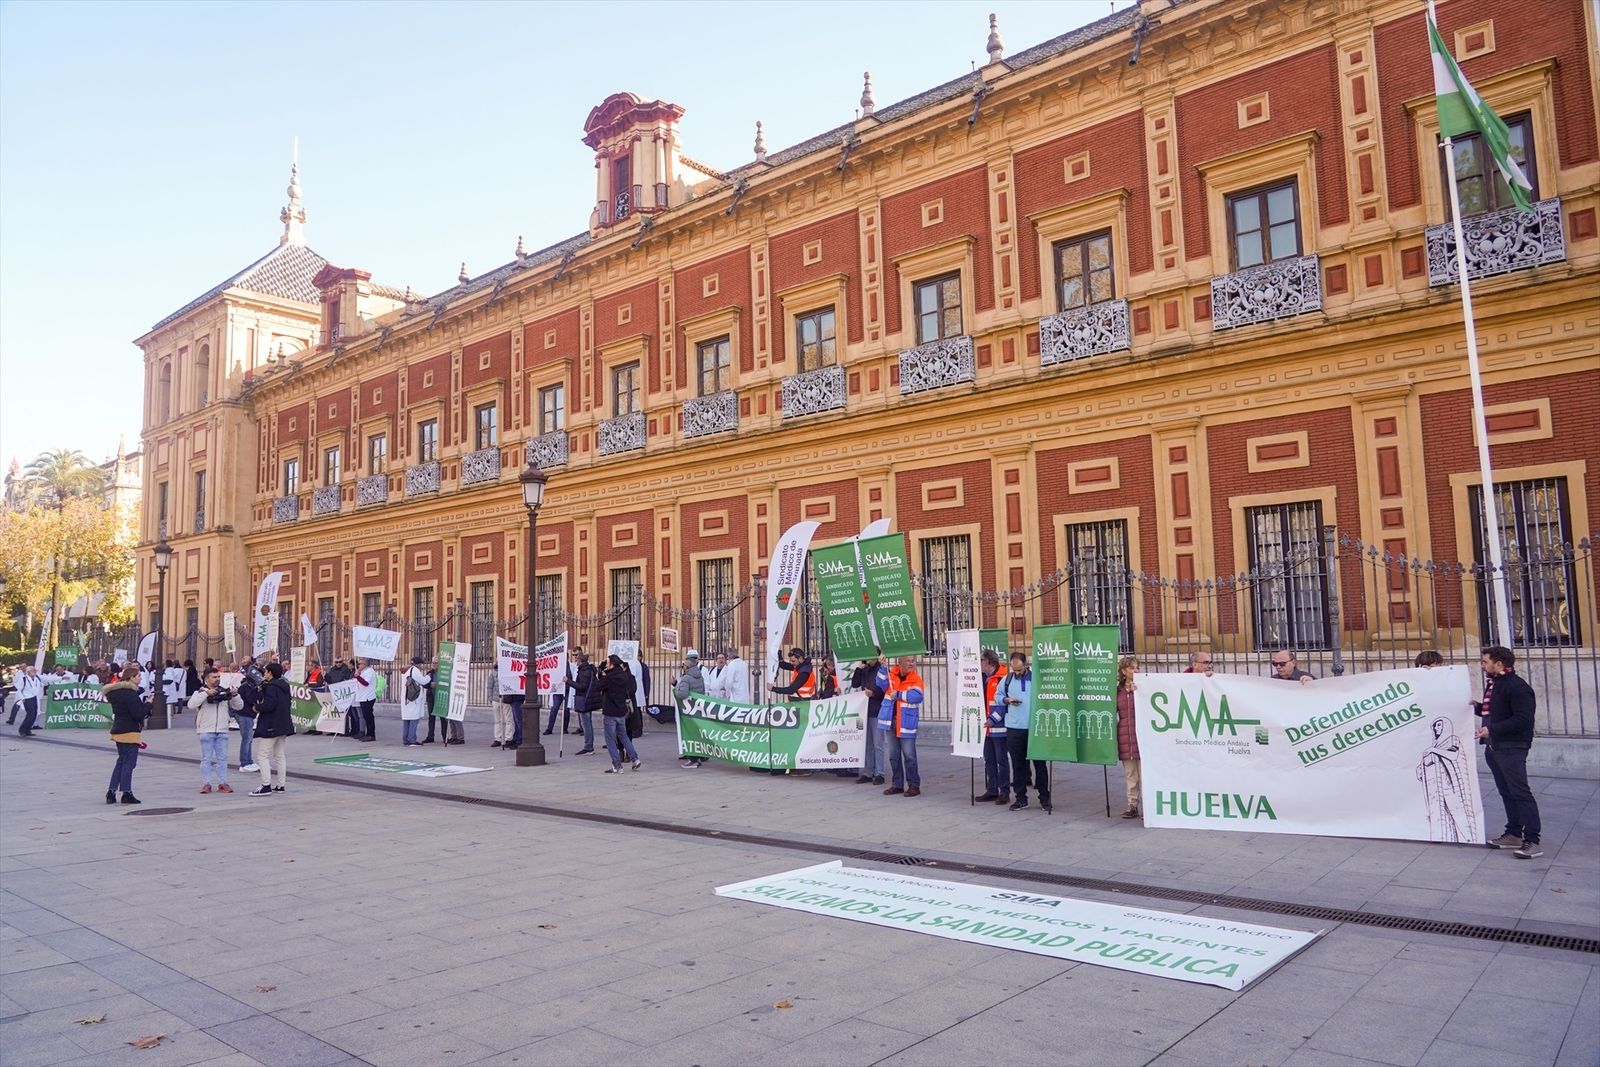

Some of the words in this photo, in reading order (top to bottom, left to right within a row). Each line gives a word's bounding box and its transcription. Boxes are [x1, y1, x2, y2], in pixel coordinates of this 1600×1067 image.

[777, 545, 788, 585] Sindicato
[785, 553, 795, 585] Médico
[790, 540, 797, 551] de
[818, 560, 850, 574] SMA
[866, 552, 899, 566] SMA
[826, 581, 854, 589] SINDICATO
[873, 573, 901, 581] SINDICATO
[877, 590, 903, 598] ANDALUZ
[829, 607, 859, 616] CÓRDOBA
[876, 600, 907, 609] CÓRDOBA
[257, 623, 267, 647] SMA
[56, 648, 75, 659] SMA
[1037, 641, 1067, 656] SMA
[1074, 641, 1111, 656] SMA
[511, 660, 523, 672] NO
[1038, 692, 1069, 700] CÓRDOBA
[682, 696, 798, 728] SALVEMOS
[812, 700, 859, 729] SMA
[1151, 689, 1260, 738] SMA
[1284, 680, 1411, 743] Defendiendo
[699, 727, 770, 743] nuestra
[1298, 743, 1329, 765] tus
[1332, 702, 1423, 752] derechos
[681, 739, 728, 760] ATENCIÓN
[730, 748, 788, 766] PRIMARIA
[1228, 747, 1251, 755] Huelva
[1156, 791, 1277, 820] HUELVA
[990, 892, 1062, 909] SMA
[853, 887, 953, 907] DIGNIDAD
[956, 904, 983, 912] DE
[1102, 926, 1120, 935] Y
[1121, 929, 1268, 957] PACIENTES
[1123, 911, 1210, 929] Sindicato
[742, 885, 889, 916] SALVEMOS
[882, 908, 919, 922] LA
[921, 915, 1075, 947] SANIDAD
[1074, 939, 1240, 979] PÚBLICA
